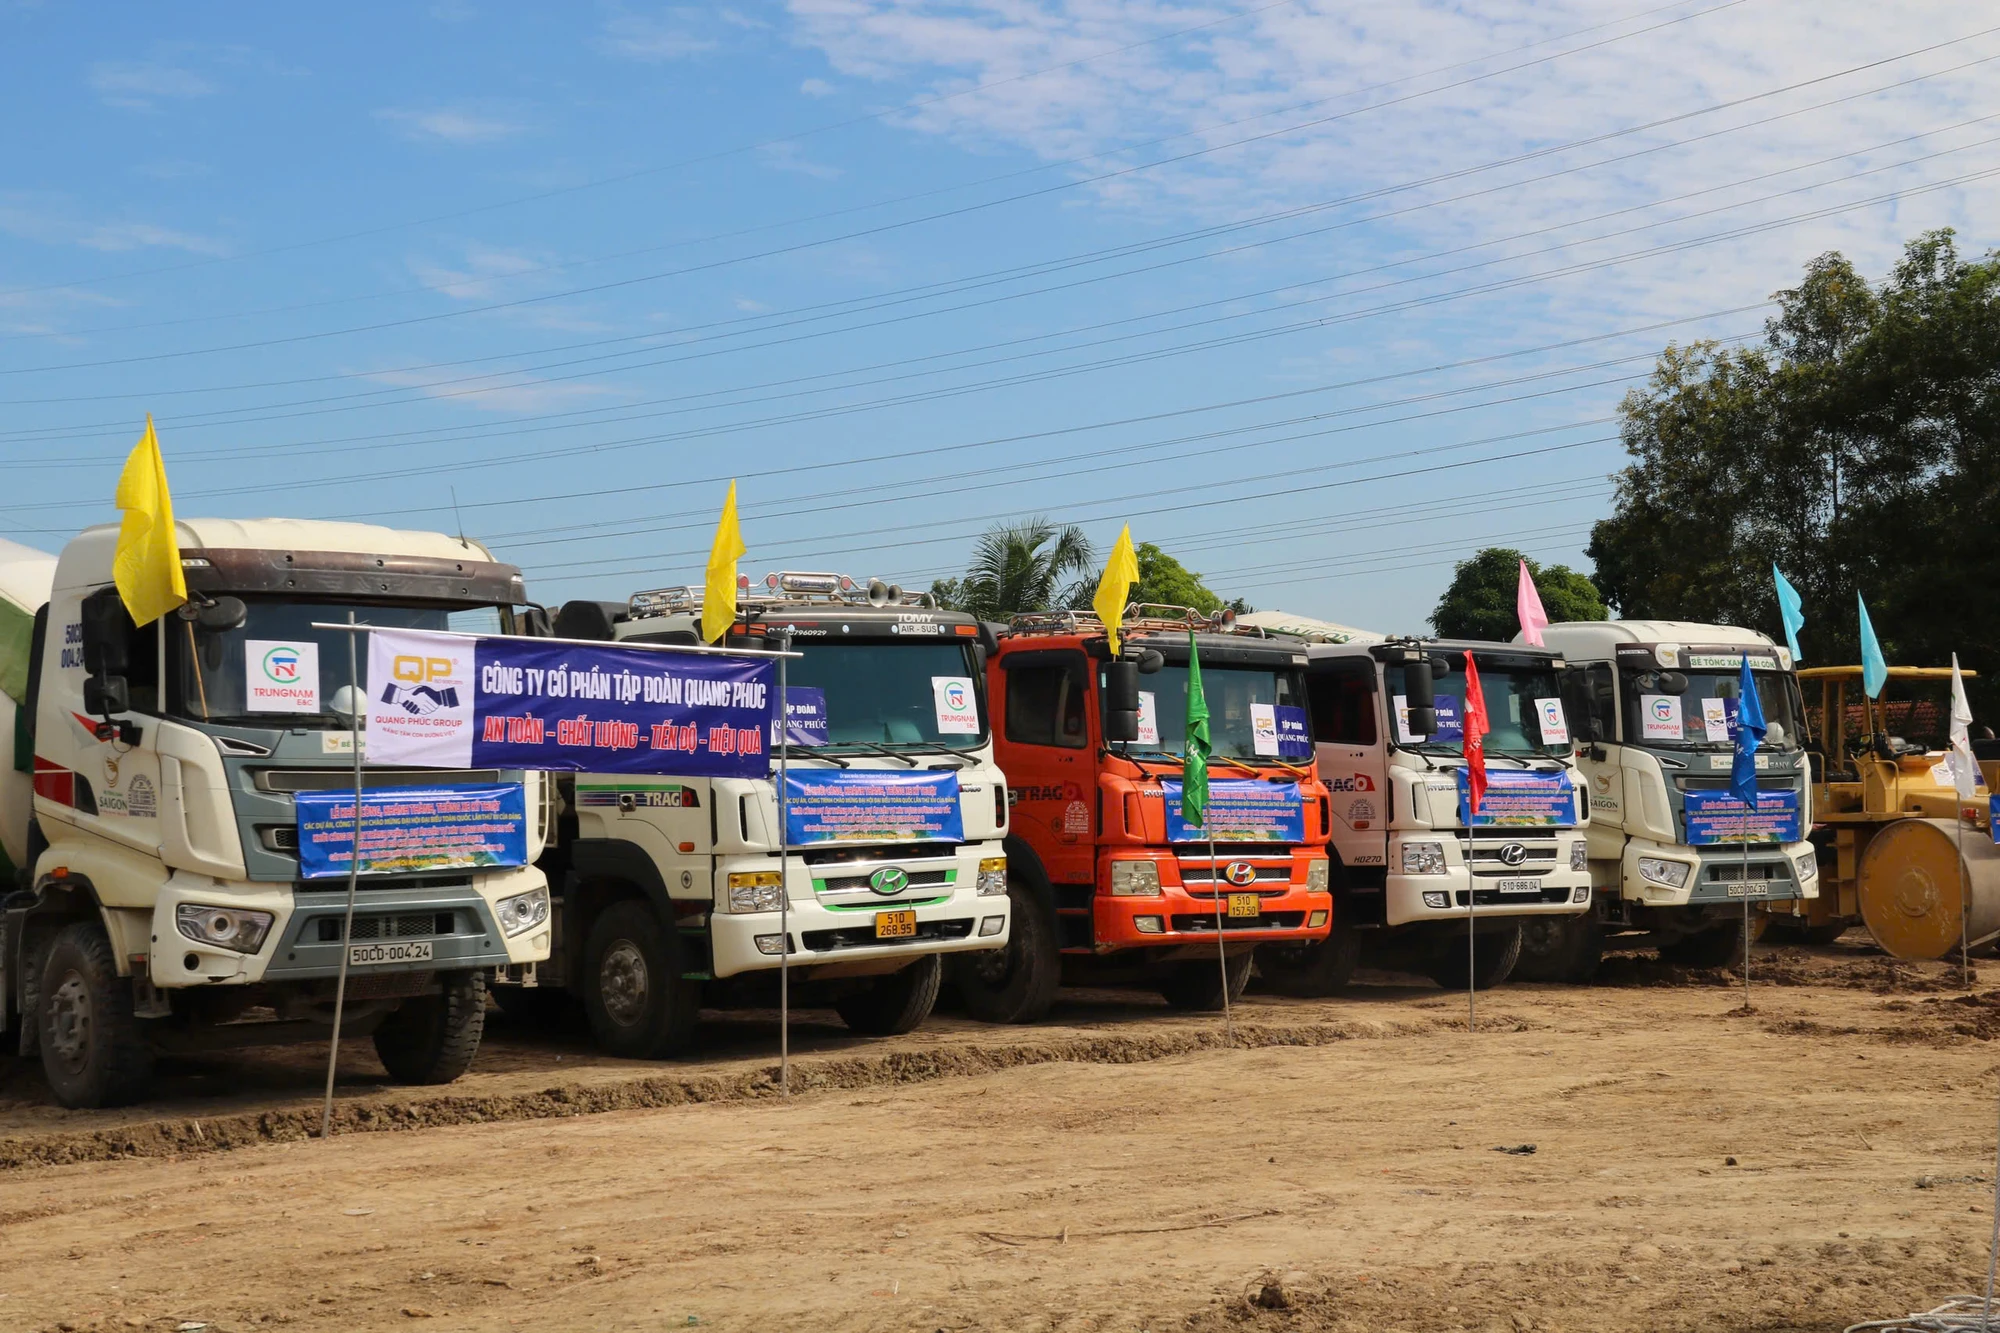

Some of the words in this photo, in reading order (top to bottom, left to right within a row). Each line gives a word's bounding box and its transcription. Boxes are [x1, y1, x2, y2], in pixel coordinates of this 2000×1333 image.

[896, 614, 934, 622] TOMY
[1704, 658, 1726, 666] TÔNG
[393, 655, 452, 684] QP
[482, 660, 522, 695] CÔNG
[525, 668, 544, 696] TY
[547, 663, 568, 697] CỔ
[570, 664, 610, 700] PHẦN
[613, 669, 642, 705] TẬP
[644, 672, 682, 704] ĐOÀN
[685, 679, 730, 708] QUANG
[732, 678, 766, 709] PHÚC
[254, 688, 314, 698] TRUNGNAM
[786, 703, 795, 715] ẬP
[796, 704, 816, 714] ĐOÀN
[376, 716, 406, 725] QUANG
[408, 717, 431, 726] PHÚC
[433, 719, 462, 728] GROUP
[774, 720, 802, 730] QANG
[804, 718, 826, 729] PHÚC
[482, 716, 505, 742] AN
[506, 712, 544, 744] TOÀN
[558, 714, 594, 746] CHẤT
[595, 719, 638, 751] LƯỢNG
[650, 718, 678, 750] TIẾN
[679, 720, 698, 754] ĐỘ
[708, 722, 736, 756] HIỆU
[738, 725, 762, 756] QUẢ
[1278, 734, 1296, 742] QUANG
[1322, 778, 1368, 792] RAGO
[100, 797, 128, 810] SAIGON
[644, 792, 692, 807] TRAGO
[1354, 856, 1382, 864] HD270
[1237, 896, 1250, 906] 51D
[1232, 906, 1256, 916] 157.50
[888, 913, 904, 924] 51D
[880, 924, 912, 936] 268.95
[353, 946, 430, 962] 50CD-004.24
